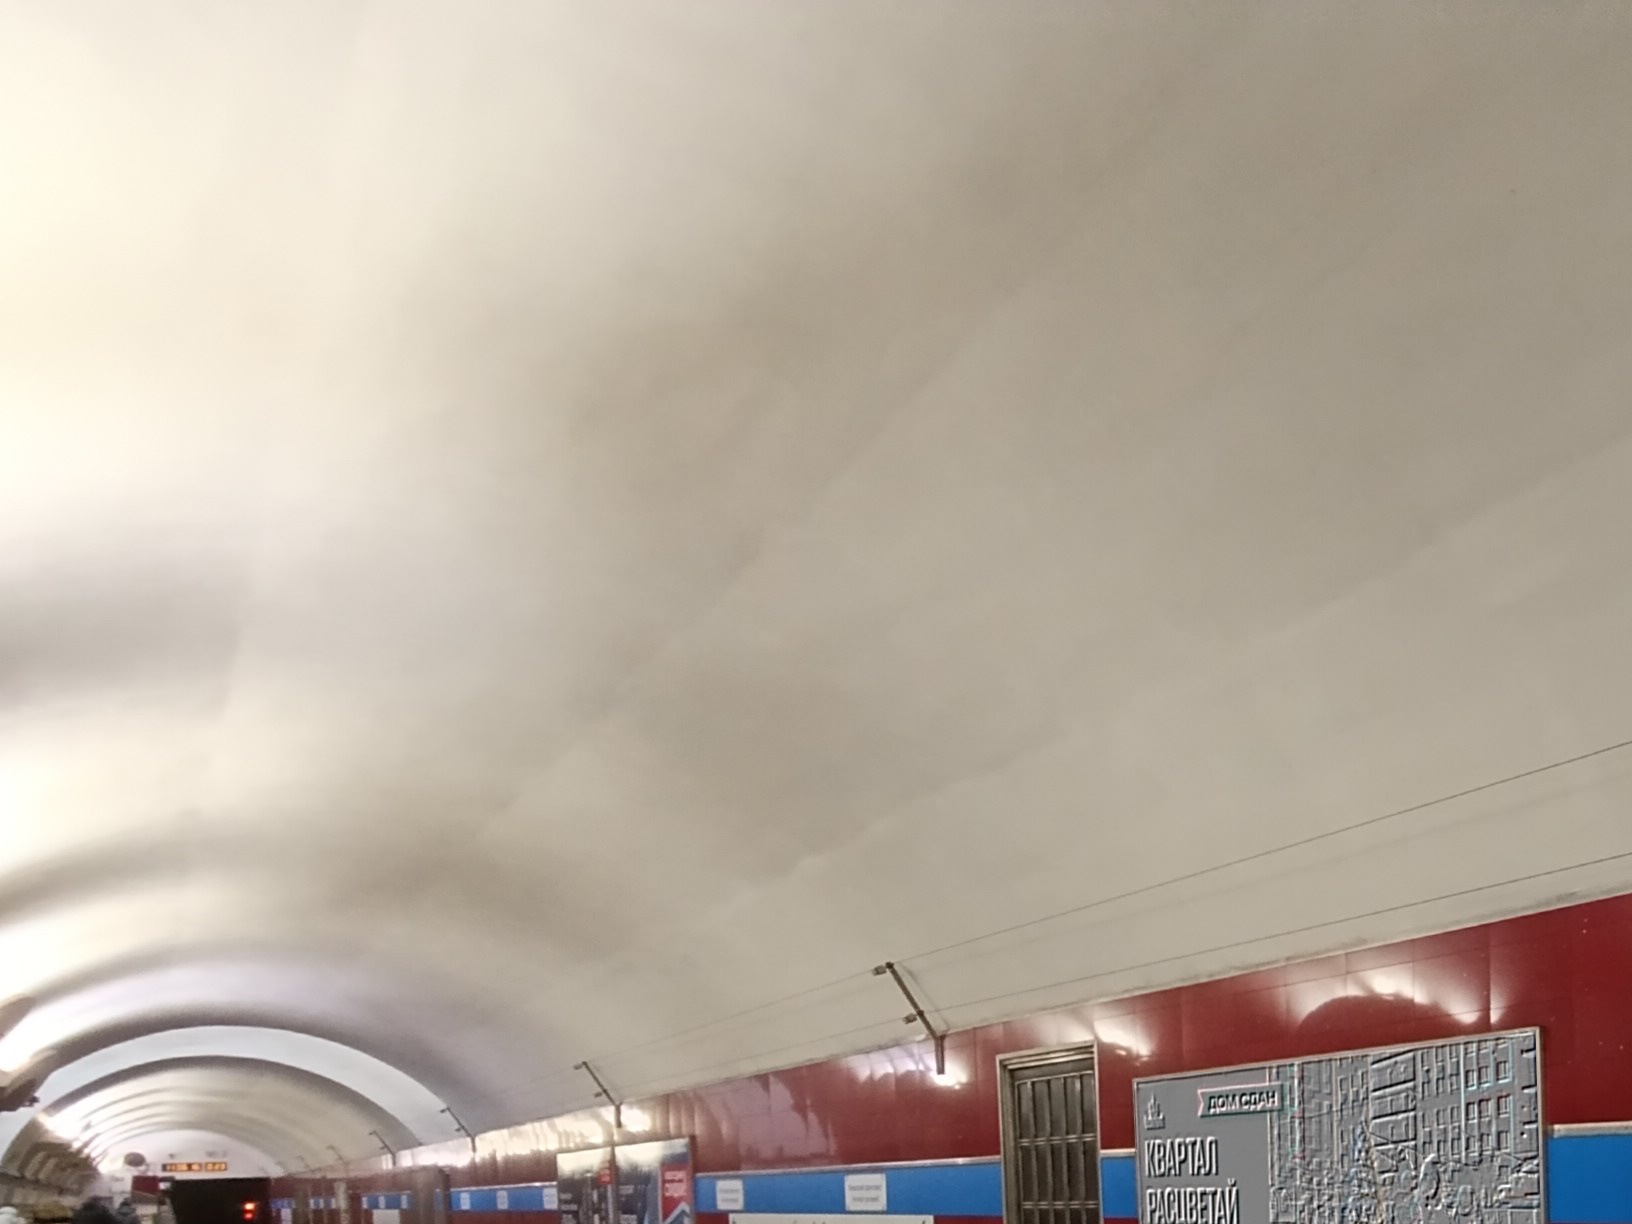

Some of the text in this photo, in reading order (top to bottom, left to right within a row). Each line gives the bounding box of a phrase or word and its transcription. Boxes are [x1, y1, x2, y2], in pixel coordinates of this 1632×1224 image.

[1208, 1090, 1278, 1114] ДОМ СДАН
[1145, 1136, 1219, 1177] КВАРТАЛ
